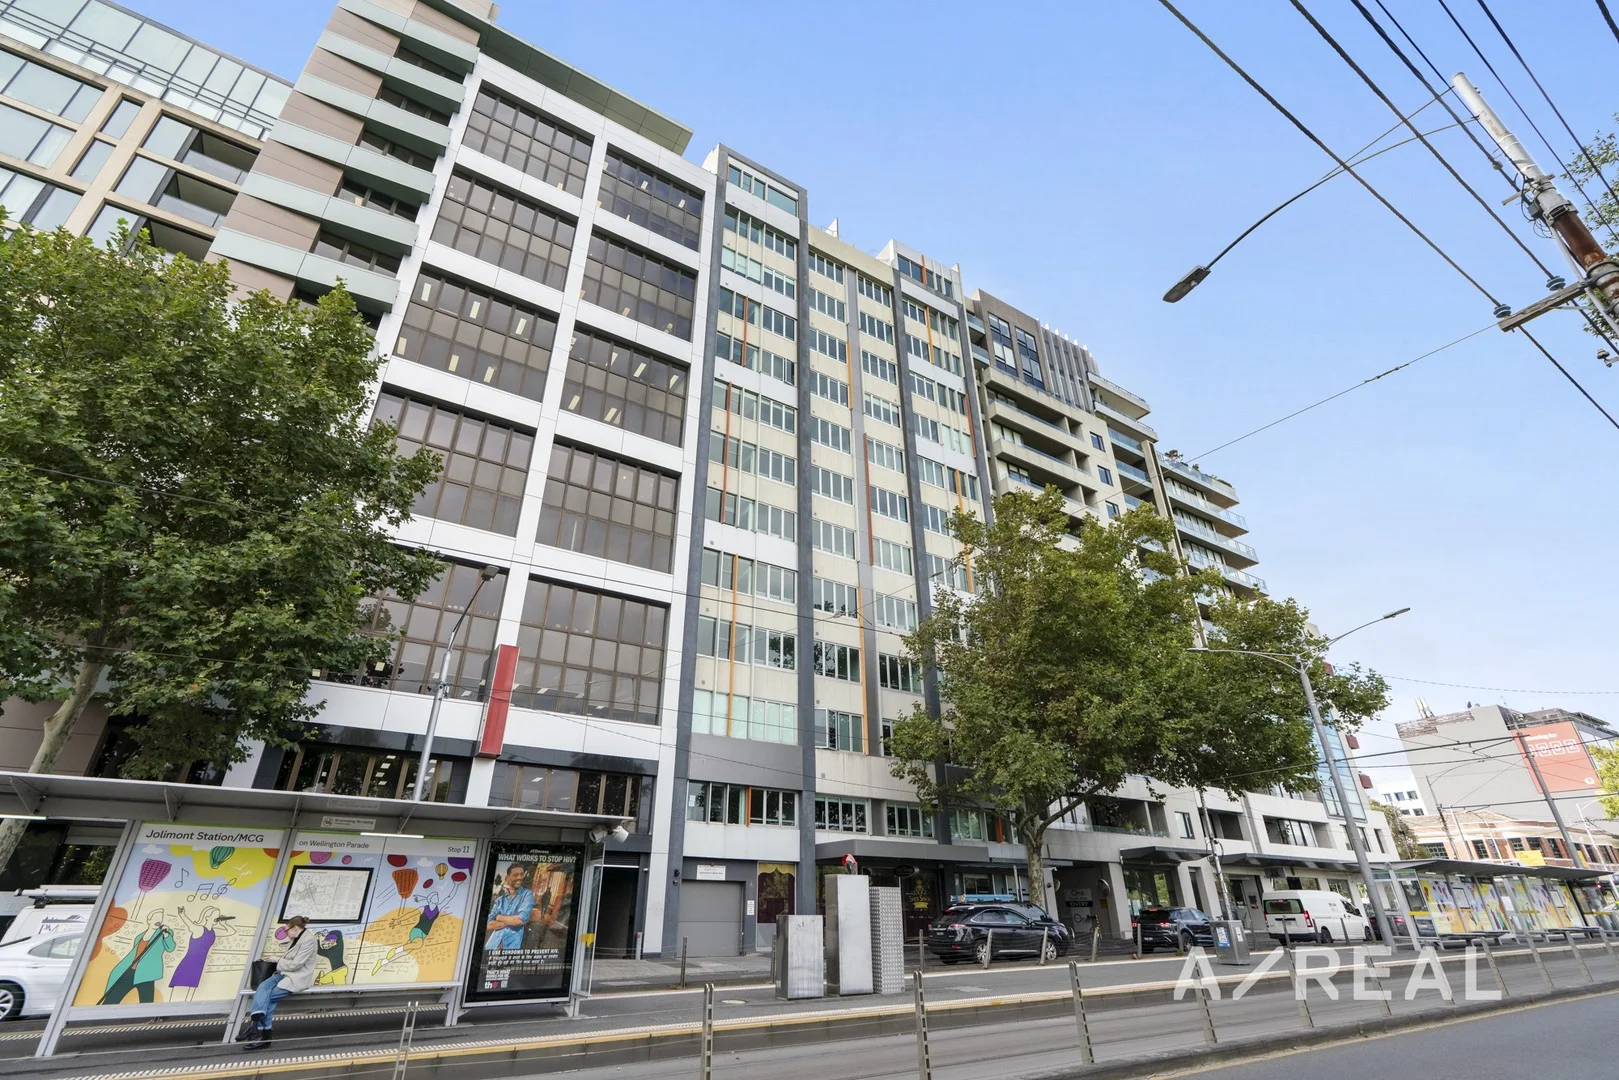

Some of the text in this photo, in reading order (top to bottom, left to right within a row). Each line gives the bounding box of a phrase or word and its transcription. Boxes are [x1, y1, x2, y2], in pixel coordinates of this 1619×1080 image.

[146, 830, 264, 842] Jolimont Station/MCG
[309, 840, 346, 849] Wellington
[462, 845, 470, 853] 11
[498, 853, 516, 861] WHAT
[517, 854, 539, 862] WORKS
[547, 855, 563, 863] STOP
